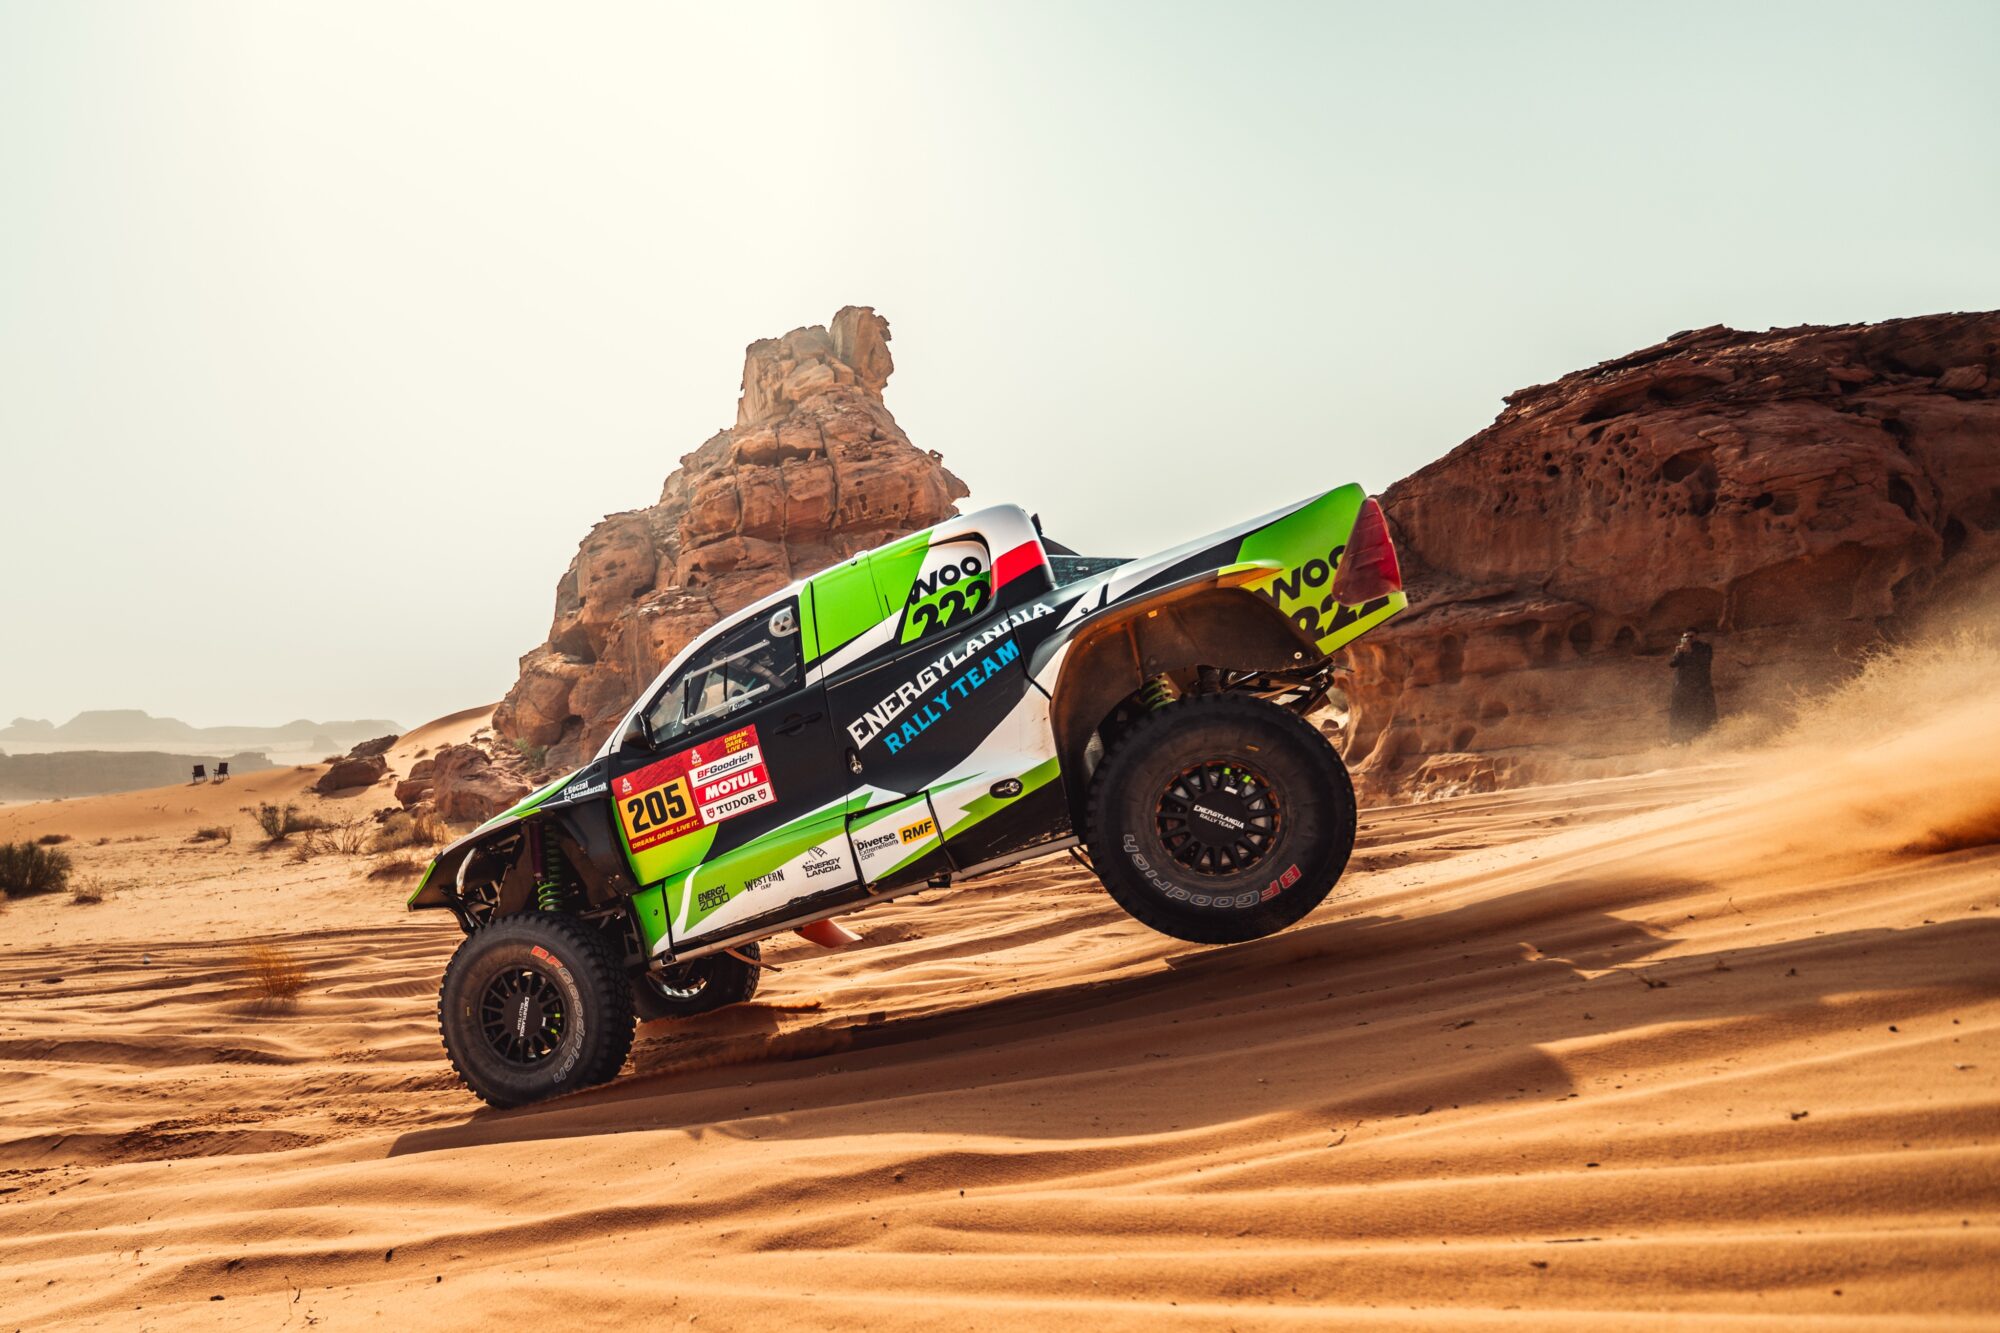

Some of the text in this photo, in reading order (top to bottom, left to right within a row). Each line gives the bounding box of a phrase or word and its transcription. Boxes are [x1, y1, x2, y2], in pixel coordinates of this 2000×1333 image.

[912, 580, 990, 640] 222
[846, 602, 1056, 750] ENERGYLANDIA
[883, 639, 1021, 755] RALLY TEAM
[724, 730, 748, 743] DREAM.
[725, 738, 744, 748] DARE.
[727, 741, 749, 753] LIVE IT.
[697, 752, 753, 779] BFGoodrich
[705, 770, 757, 800] MOTUL
[627, 783, 687, 834] 205
[716, 793, 757, 815] TUDOR
[1193, 804, 1244, 829] ENERGYLANDIA
[1199, 812, 1235, 830] RALLY TEAM
[632, 819, 699, 849] DREAM. DARE. LIVE IT.
[857, 832, 896, 851] Diverse
[902, 821, 932, 842] RMF
[859, 839, 899, 856] ExtremeTeam
[804, 857, 841, 872] ENERGY
[806, 864, 841, 878] LANDIA
[1123, 834, 1302, 908] BFGoodrich
[744, 869, 785, 892] WESTERN
[698, 884, 726, 902] ENERGY
[700, 892, 730, 911] 2000
